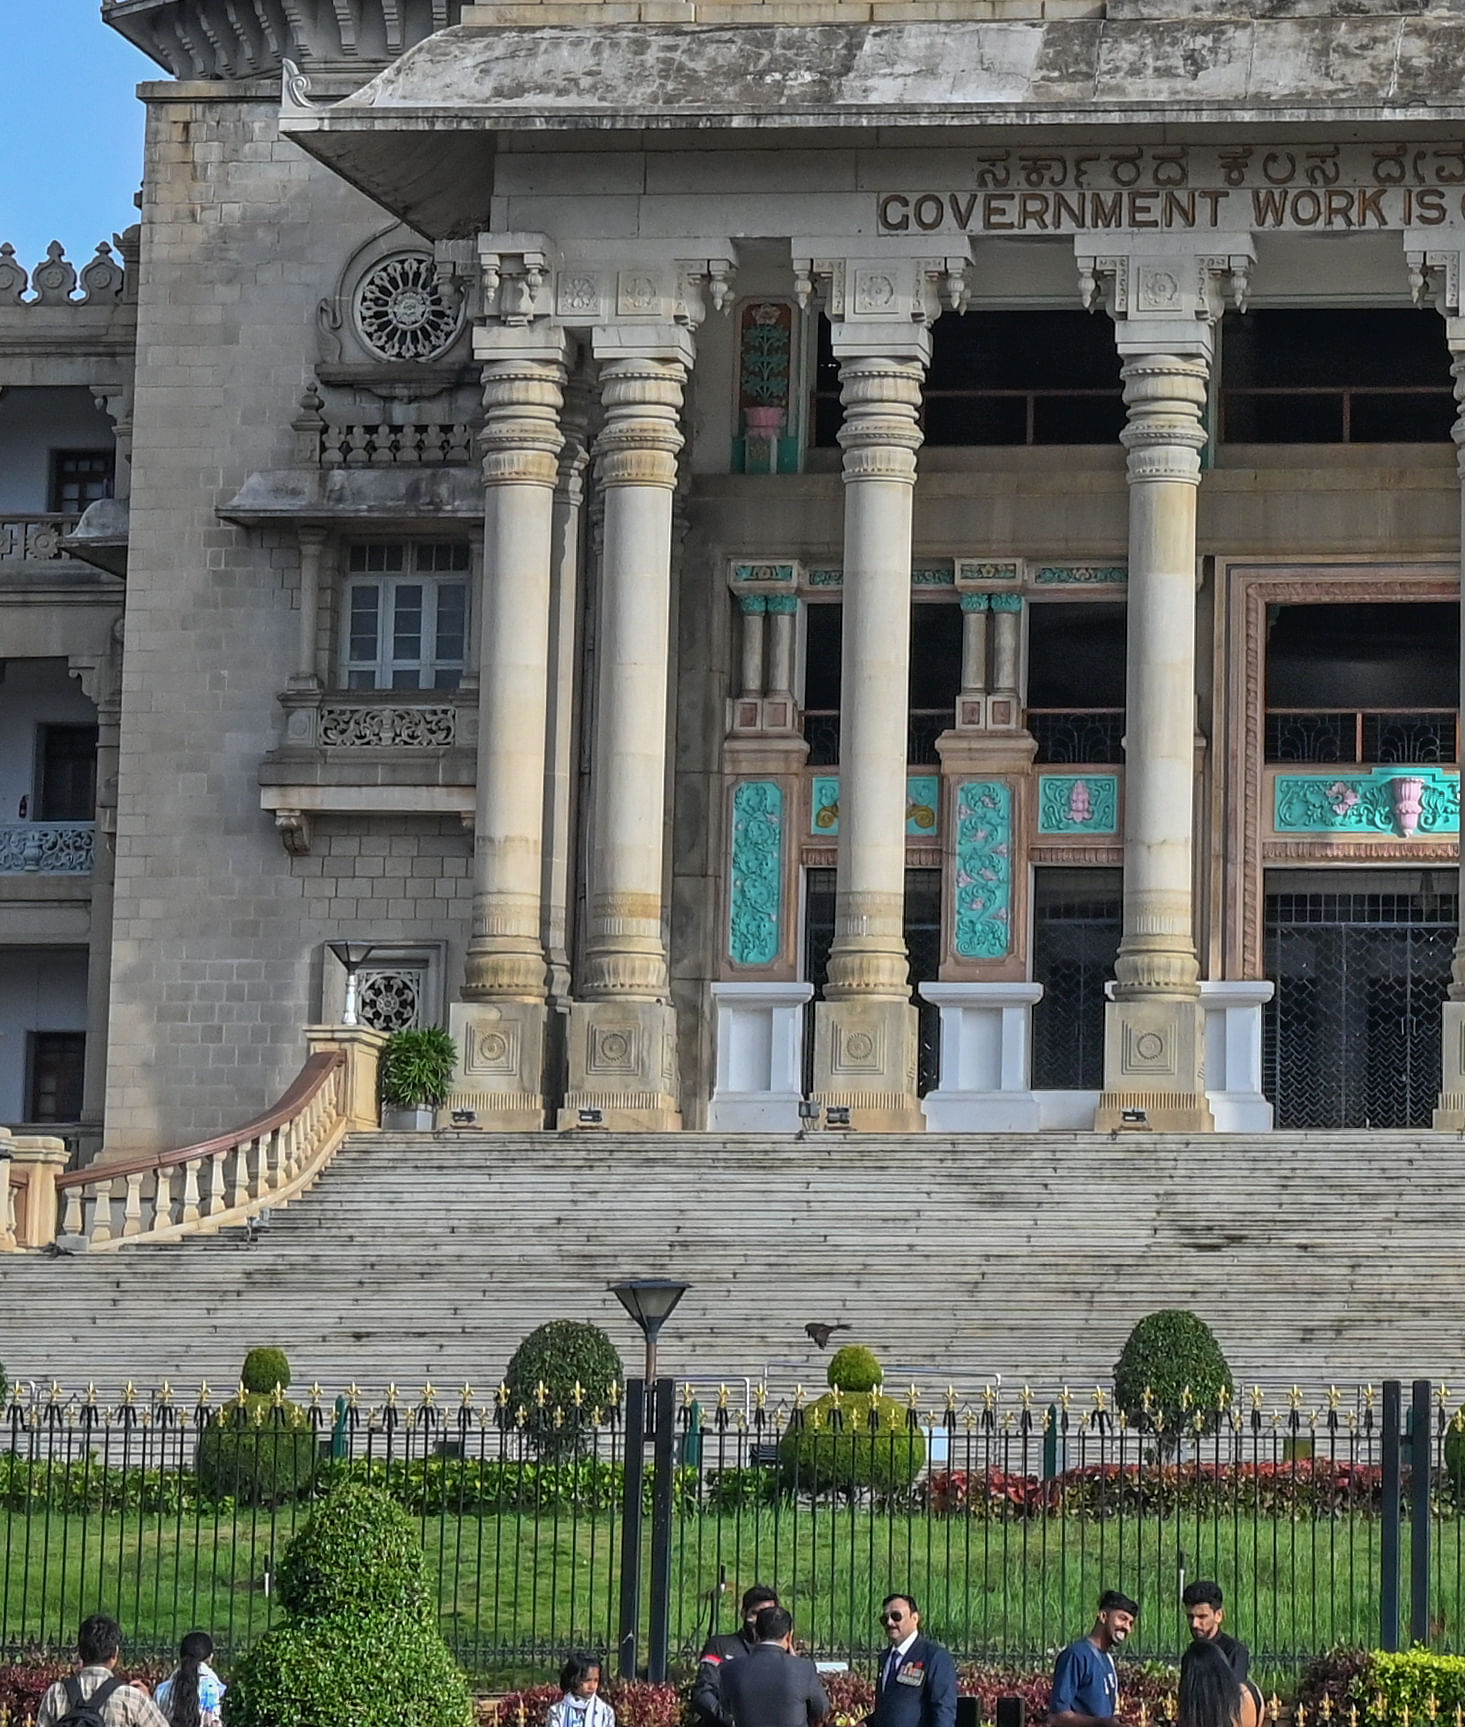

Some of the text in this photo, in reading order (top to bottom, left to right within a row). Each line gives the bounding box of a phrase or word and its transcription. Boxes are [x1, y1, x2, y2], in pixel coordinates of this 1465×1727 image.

[976, 148, 1188, 188] ಸರ್ಕಾರದ
[1218, 145, 1340, 186] ಕೆಲಸ
[877, 189, 1230, 231] GOVERNMENT
[1251, 188, 1389, 228] WORK
[1402, 187, 1447, 226] IS
